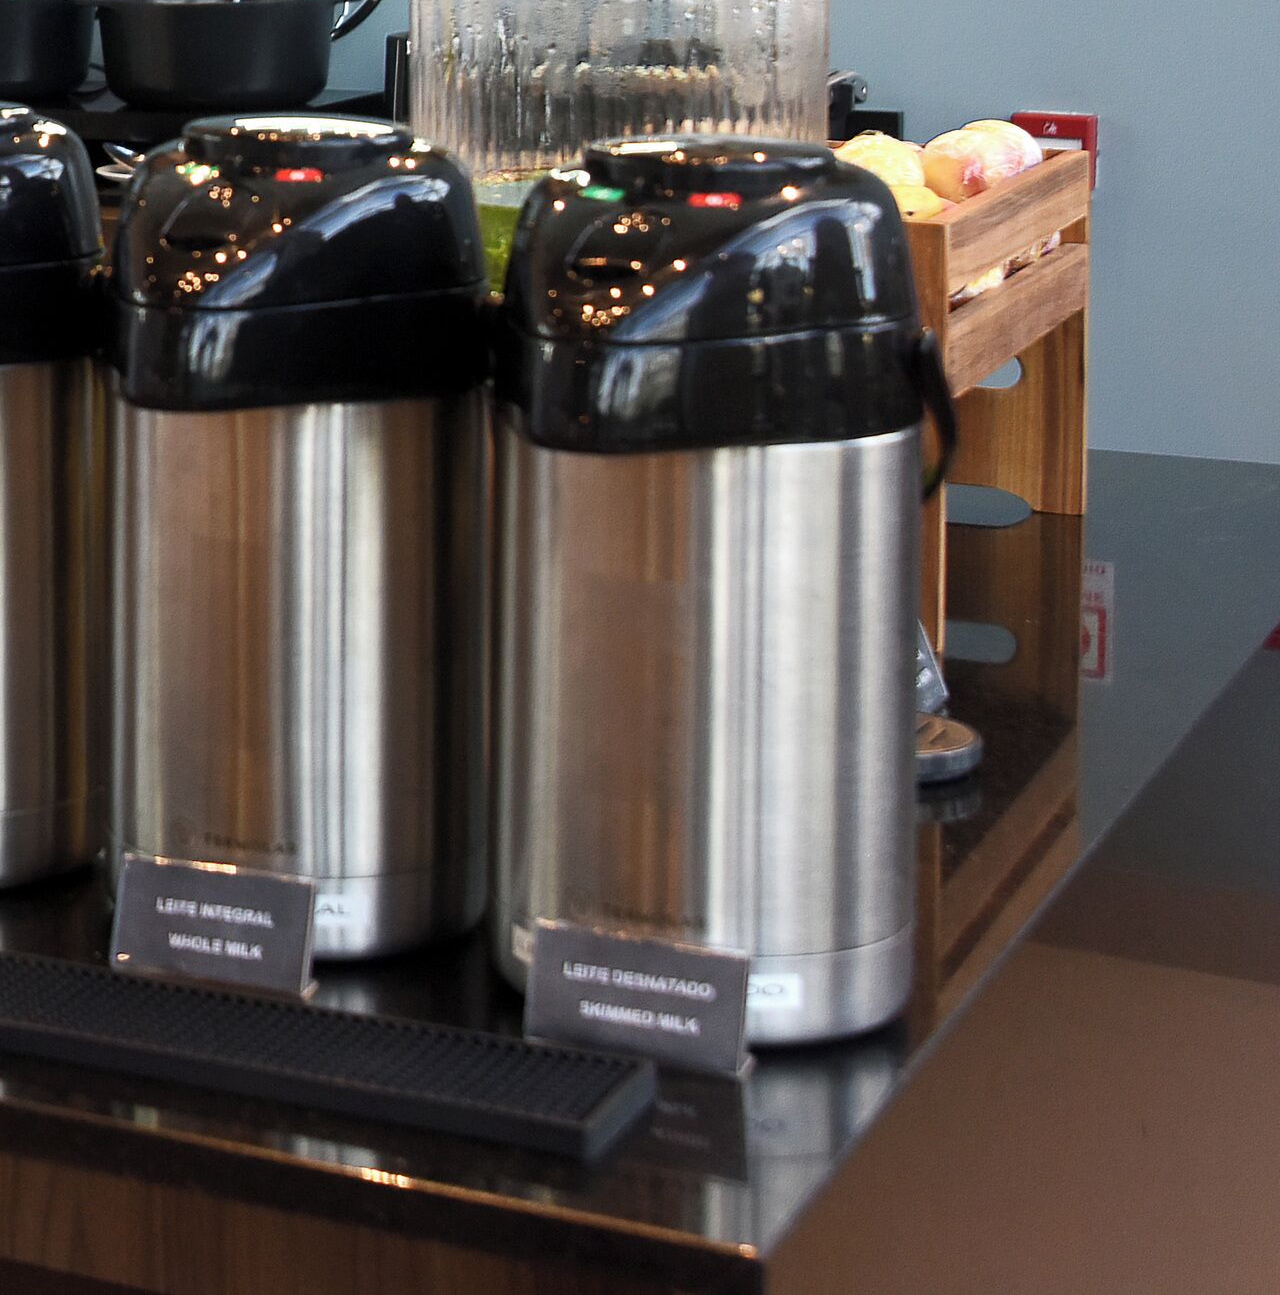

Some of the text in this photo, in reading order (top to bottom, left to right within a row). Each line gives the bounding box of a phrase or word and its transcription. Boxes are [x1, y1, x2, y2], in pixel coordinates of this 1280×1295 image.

[155, 896, 276, 929] LEITE INTEGRAL
[168, 931, 264, 961] WHOLE MILK
[562, 960, 611, 985] LEITE
[611, 968, 716, 1002] DESNATADO
[578, 999, 701, 1035] SKIMMED MILK
